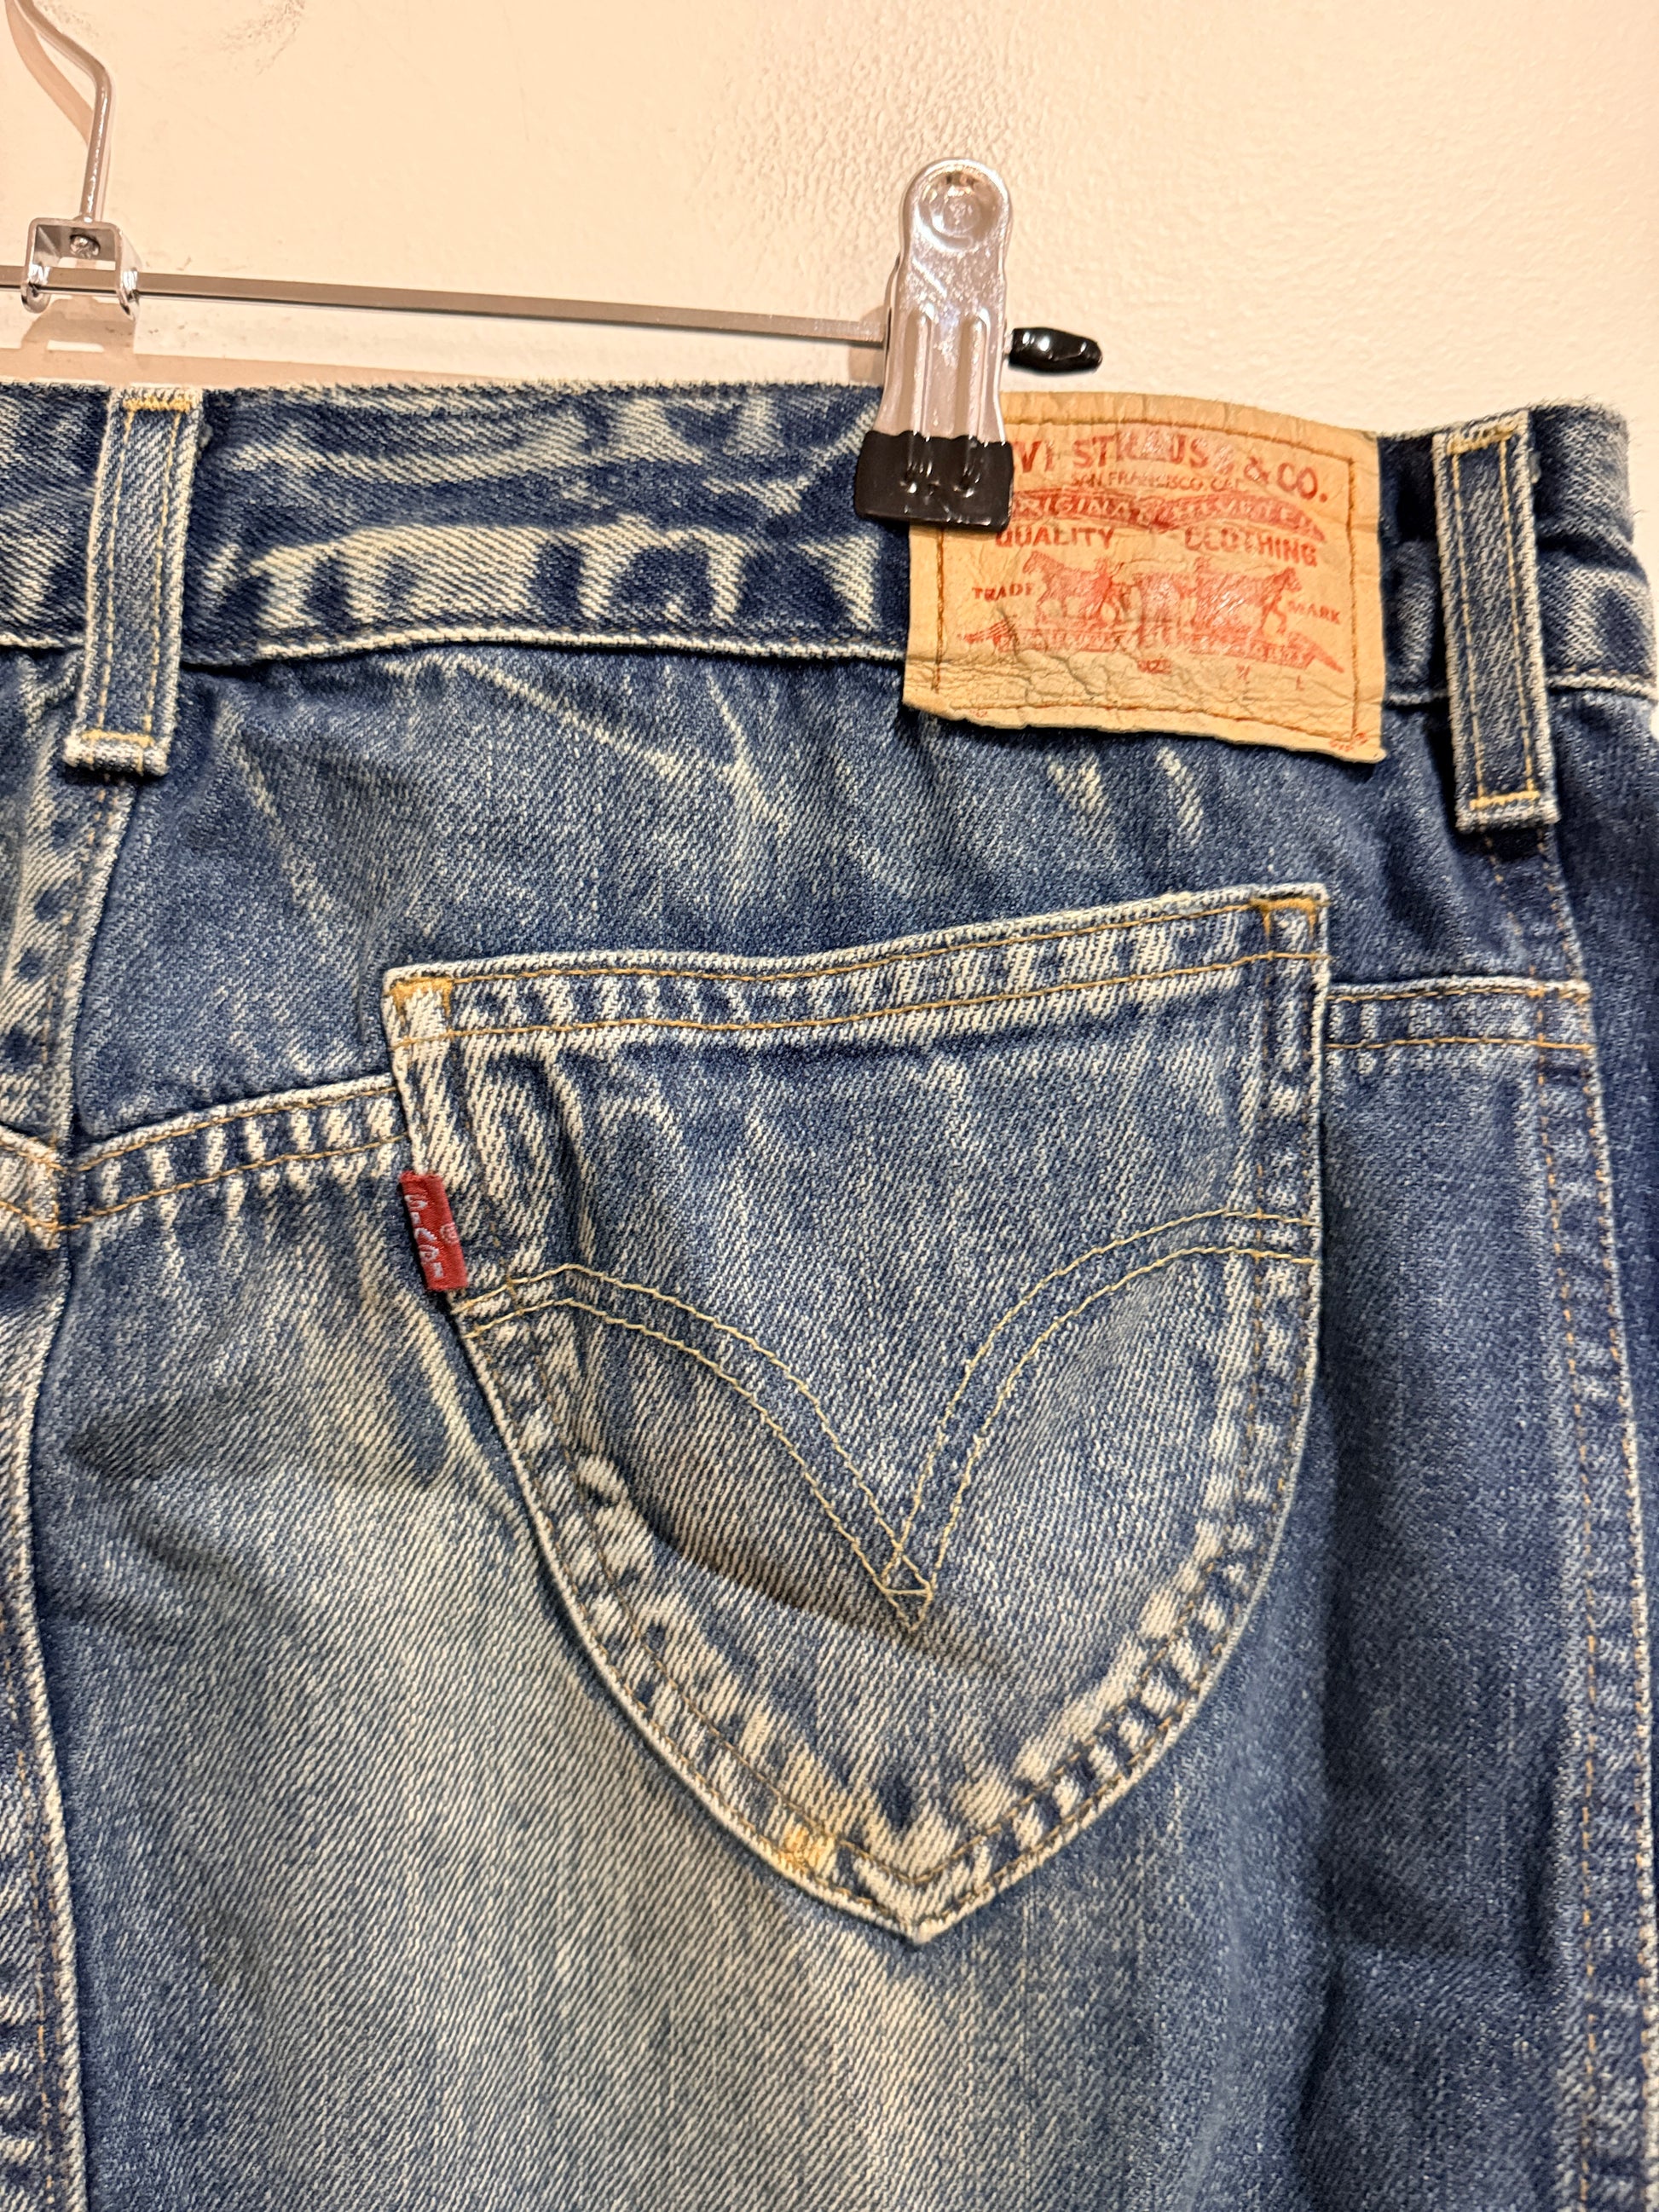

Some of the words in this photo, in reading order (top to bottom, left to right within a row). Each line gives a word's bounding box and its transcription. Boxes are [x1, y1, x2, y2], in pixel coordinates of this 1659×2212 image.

[1013, 439, 1055, 474] VI
[1244, 455, 1269, 485] &
[1277, 462, 1328, 503] CO.
[1012, 491, 1149, 525] RIGINAL
[996, 525, 1114, 550] QUALITY
[1184, 525, 1318, 567] CLOTHING
[972, 582, 1034, 602] TRADE
[1287, 598, 1341, 625] MARK
